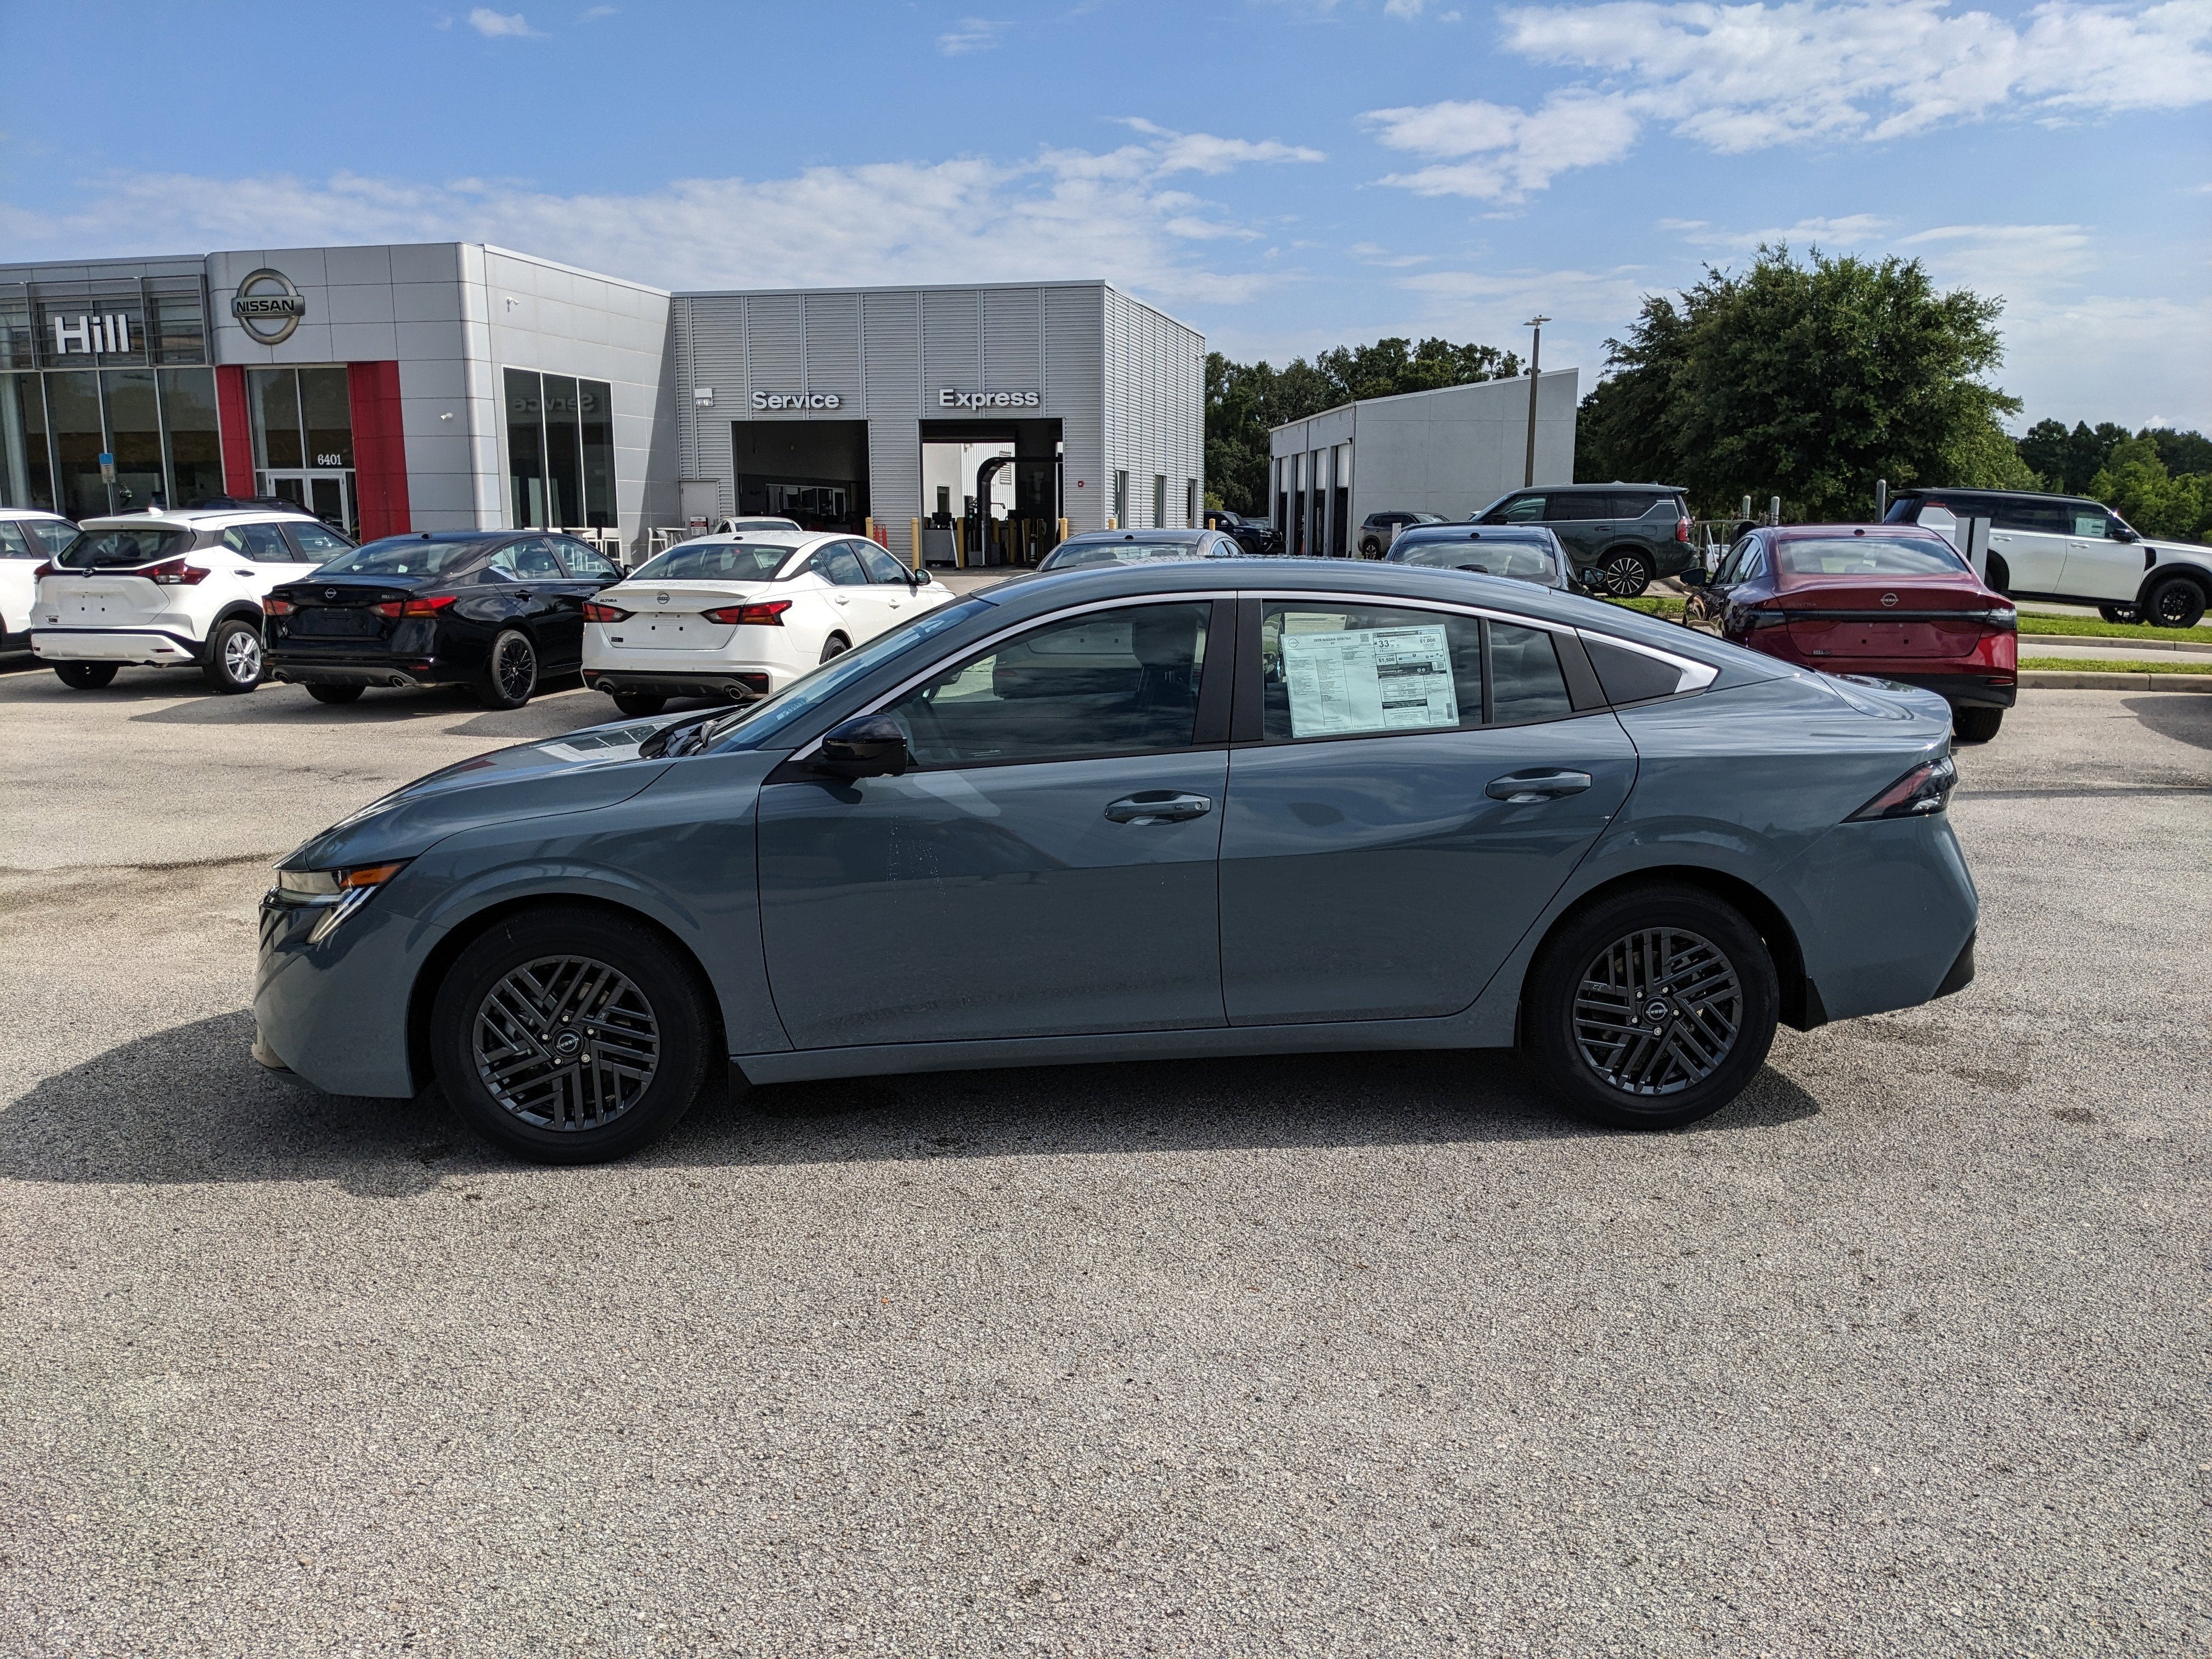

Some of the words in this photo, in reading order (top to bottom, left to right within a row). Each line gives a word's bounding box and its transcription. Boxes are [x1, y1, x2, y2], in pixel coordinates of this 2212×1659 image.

[236, 300, 295, 312] NISSAN
[54, 314, 130, 354] Hill
[752, 391, 840, 409] Service
[939, 388, 1039, 411] Express
[318, 454, 342, 465] 6401
[1378, 640, 1390, 648] 33
[556, 1037, 579, 1049] NISSAN
